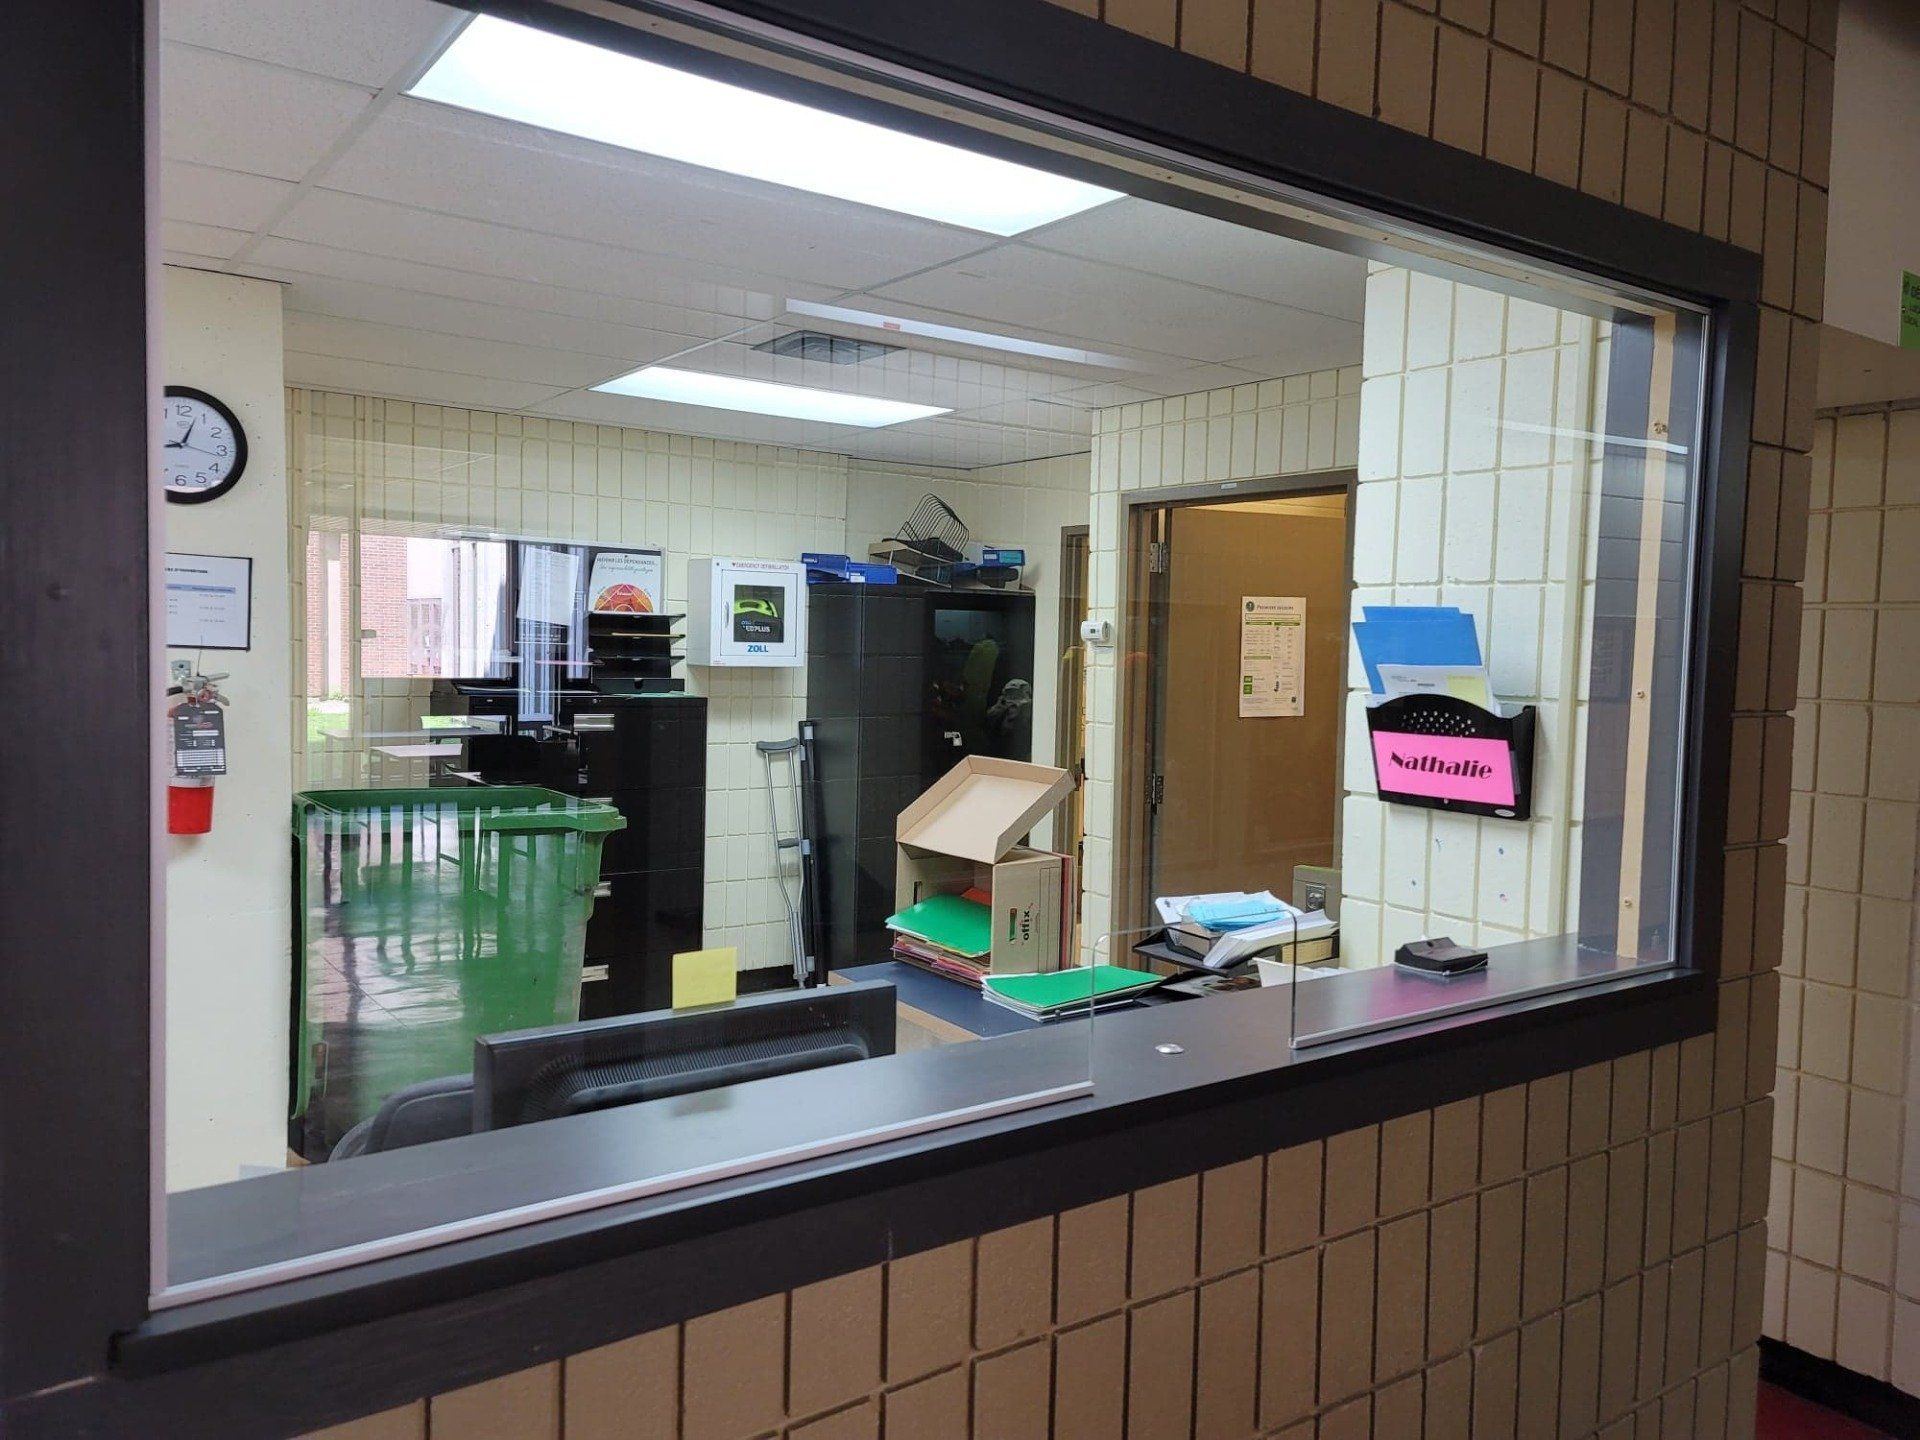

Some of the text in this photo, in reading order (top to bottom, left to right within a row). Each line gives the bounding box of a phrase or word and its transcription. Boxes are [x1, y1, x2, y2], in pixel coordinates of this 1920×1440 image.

[176, 405, 193, 417] 12
[210, 427, 222, 438] 2
[216, 445, 228, 457] 3
[208, 462, 219, 473] 4
[175, 474, 187, 486] 6
[195, 472, 207, 484] 5
[747, 644, 769, 653] ZOLL
[1388, 751, 1493, 780] Nathalie
[1021, 910, 1030, 941] offix
